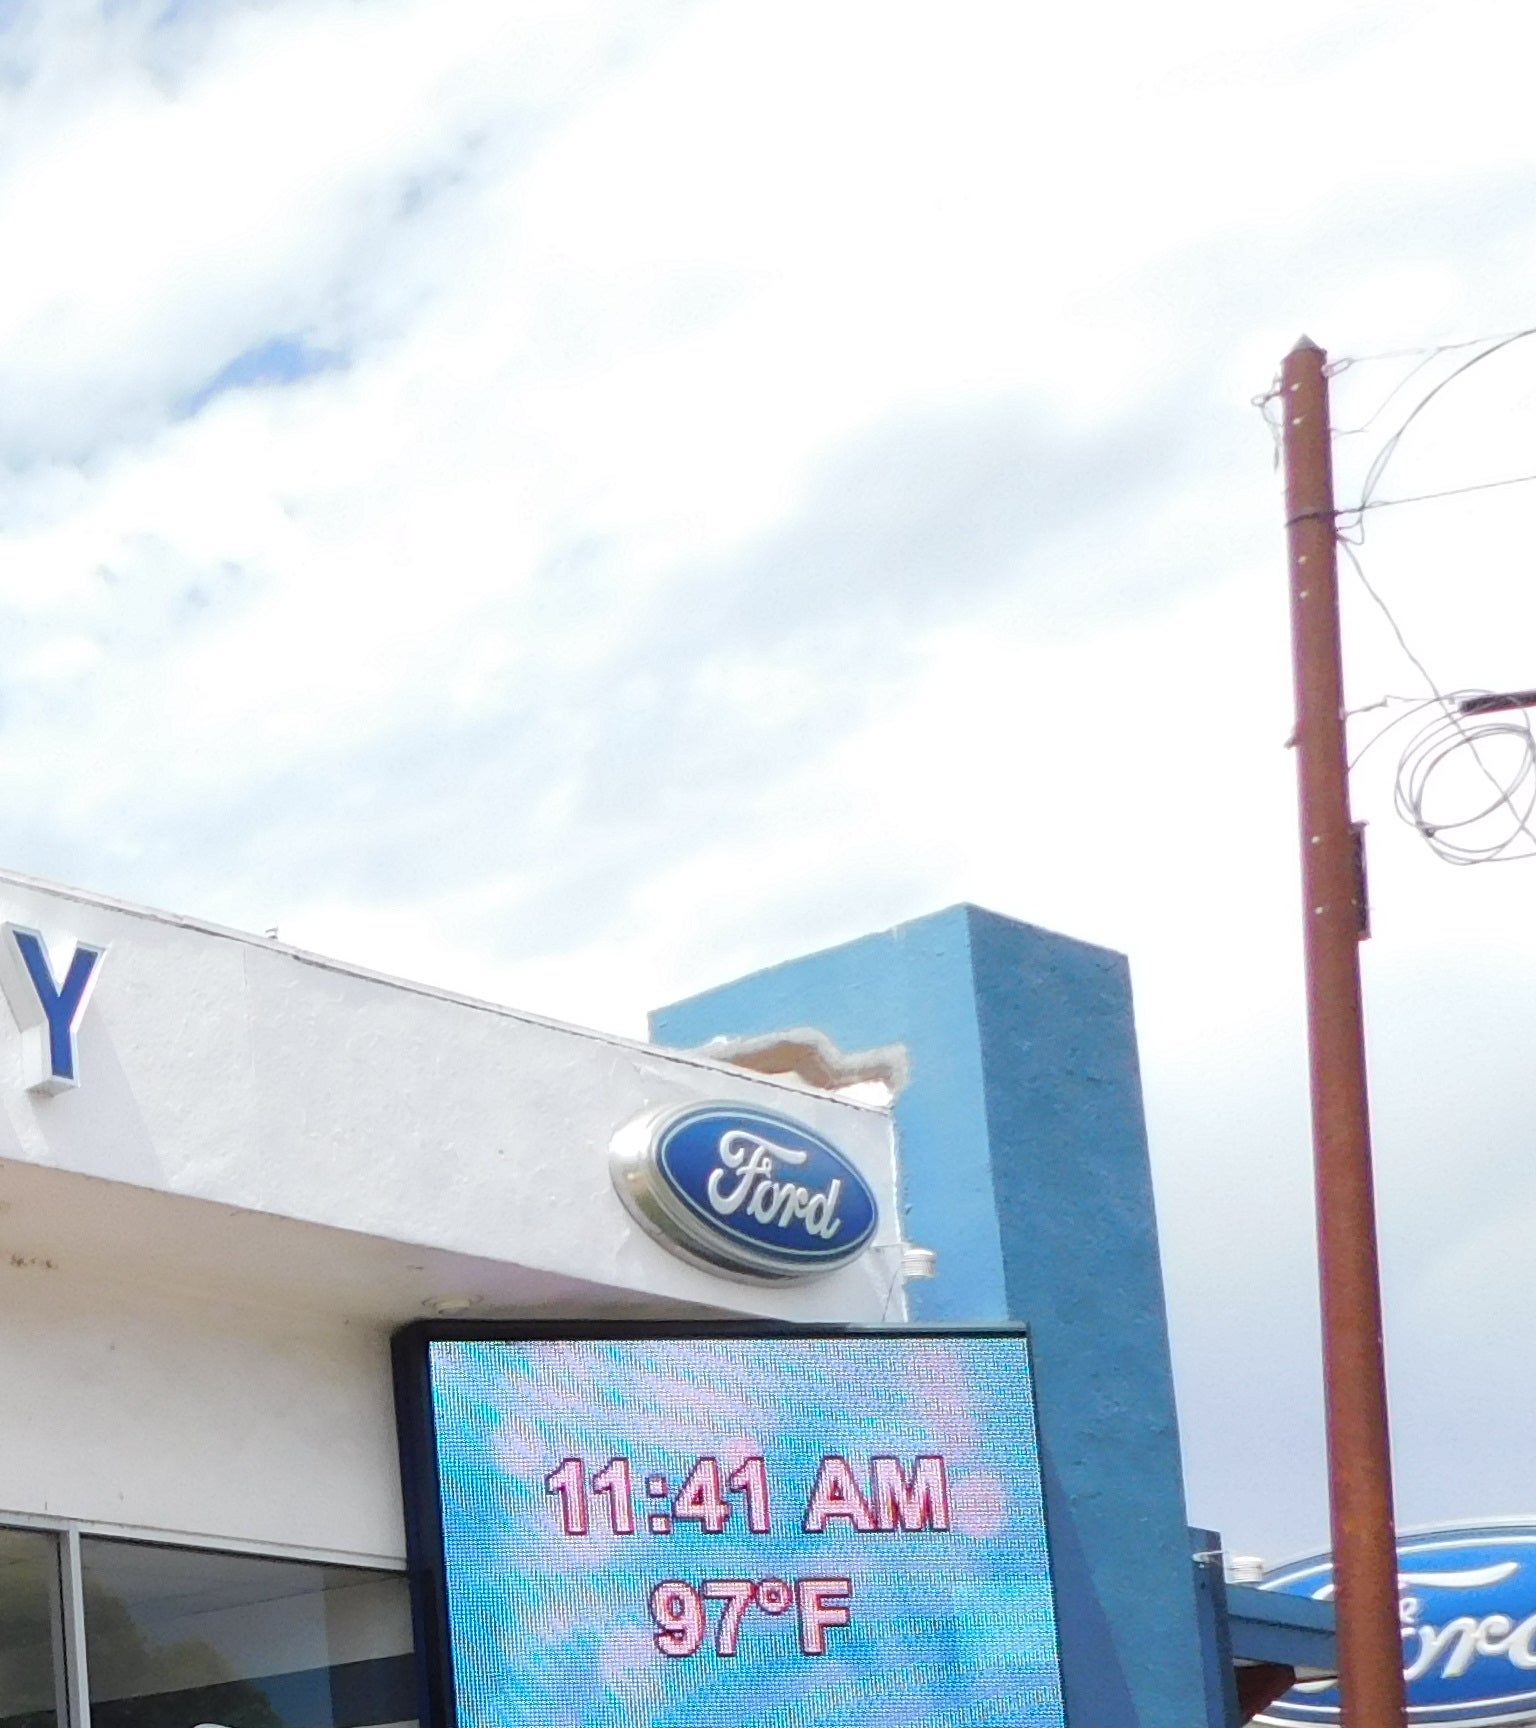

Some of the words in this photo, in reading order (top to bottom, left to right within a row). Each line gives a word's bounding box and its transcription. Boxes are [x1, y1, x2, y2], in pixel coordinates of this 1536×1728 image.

[709, 1130, 841, 1239] Ford
[545, 1455, 773, 1536] 11:41
[803, 1455, 950, 1533] AM
[650, 1574, 851, 1658] 97°F
